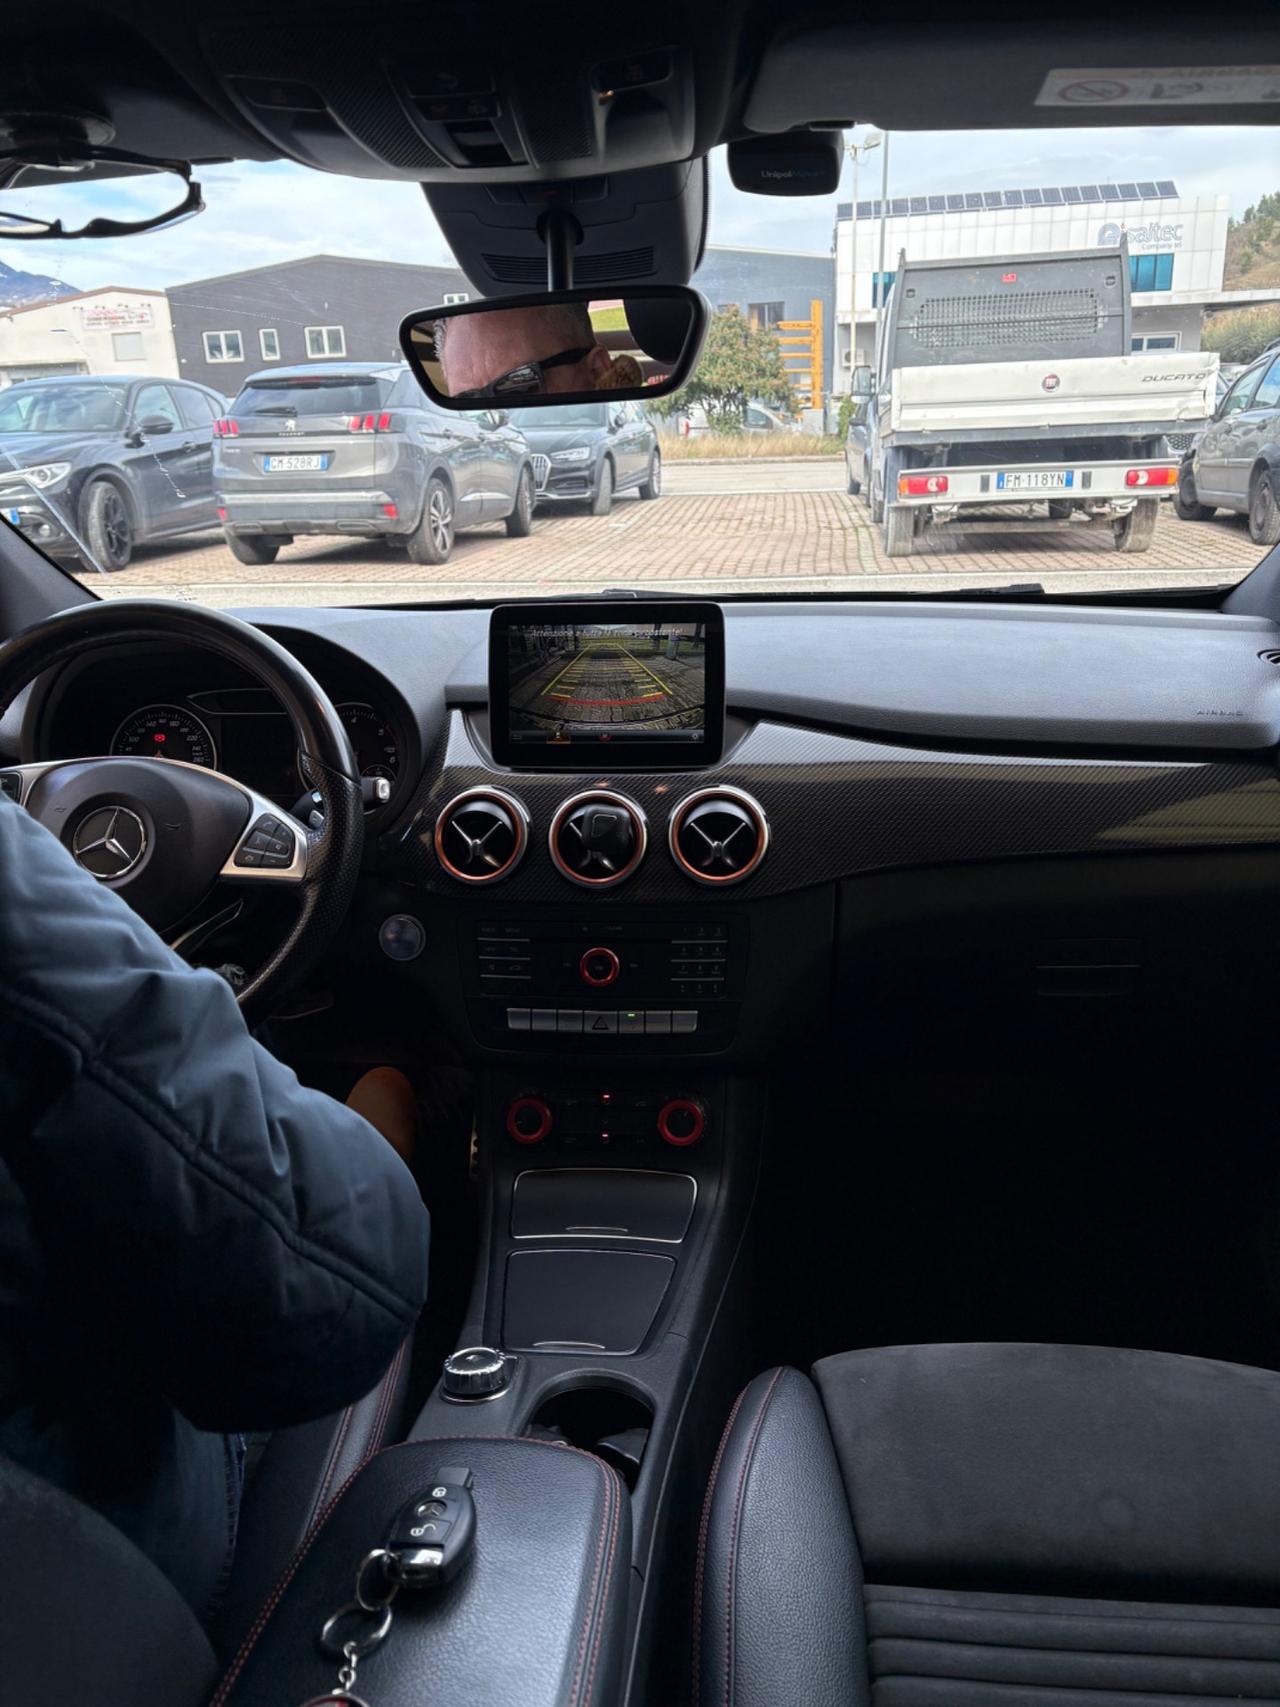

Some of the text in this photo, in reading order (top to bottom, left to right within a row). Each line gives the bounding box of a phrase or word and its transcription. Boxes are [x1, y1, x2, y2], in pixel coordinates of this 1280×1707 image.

[1142, 373, 1206, 382] DUCATO
[1006, 473, 1065, 487] FM 118YN
